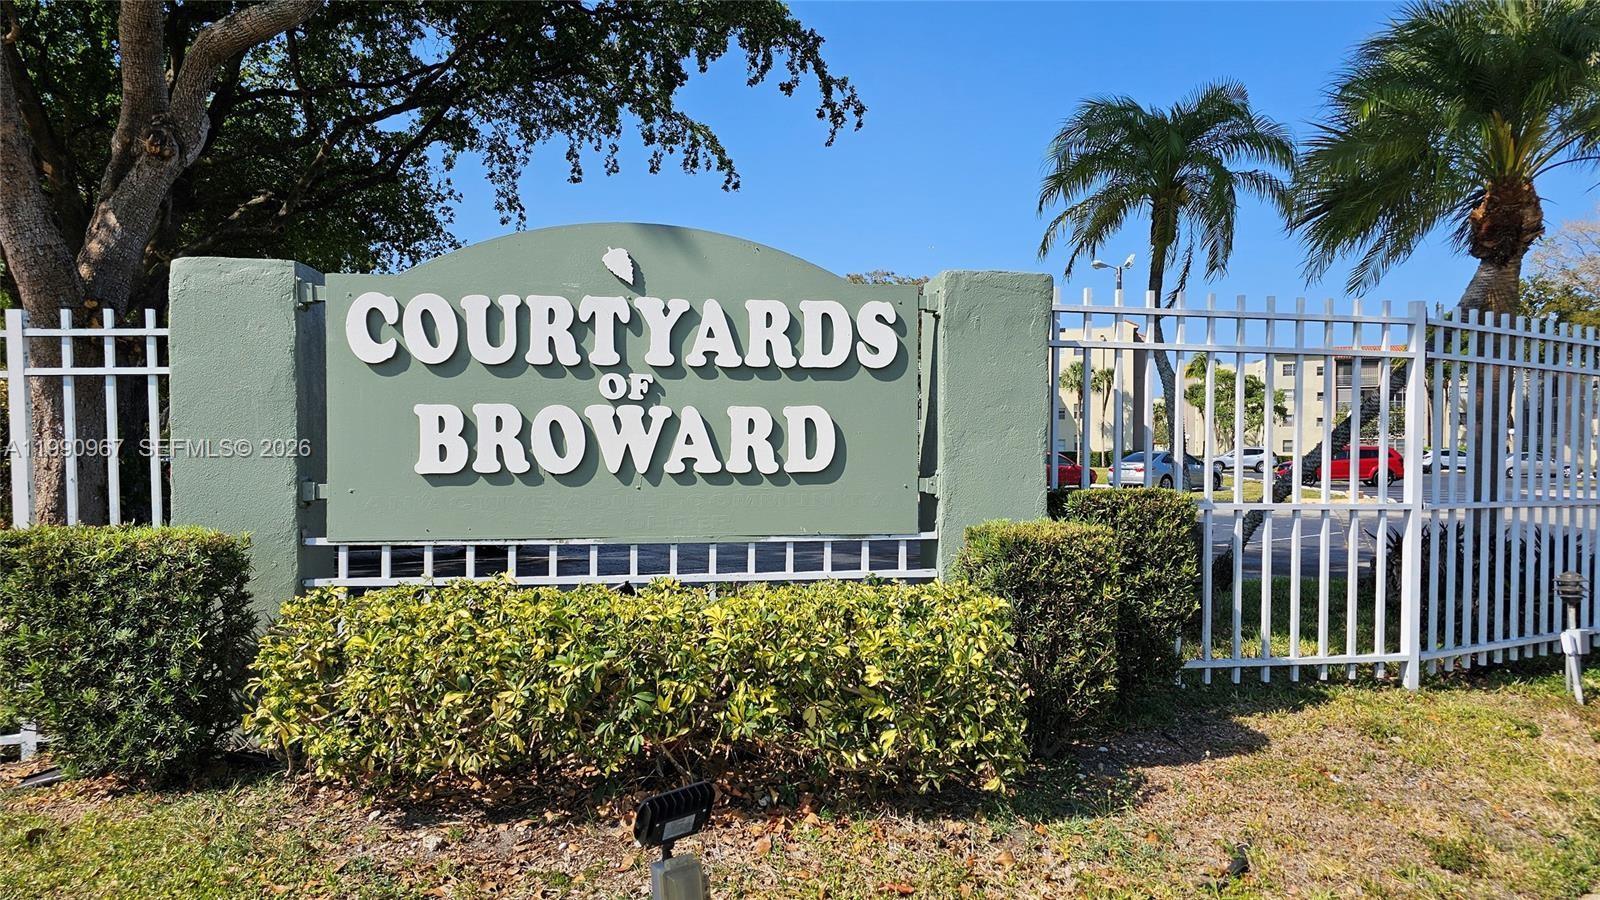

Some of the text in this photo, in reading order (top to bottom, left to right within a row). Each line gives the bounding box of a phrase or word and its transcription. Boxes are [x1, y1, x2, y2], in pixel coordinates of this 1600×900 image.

[345, 291, 899, 369] COURTYARDS
[598, 372, 654, 400] OF
[412, 403, 836, 475] BROWARD
